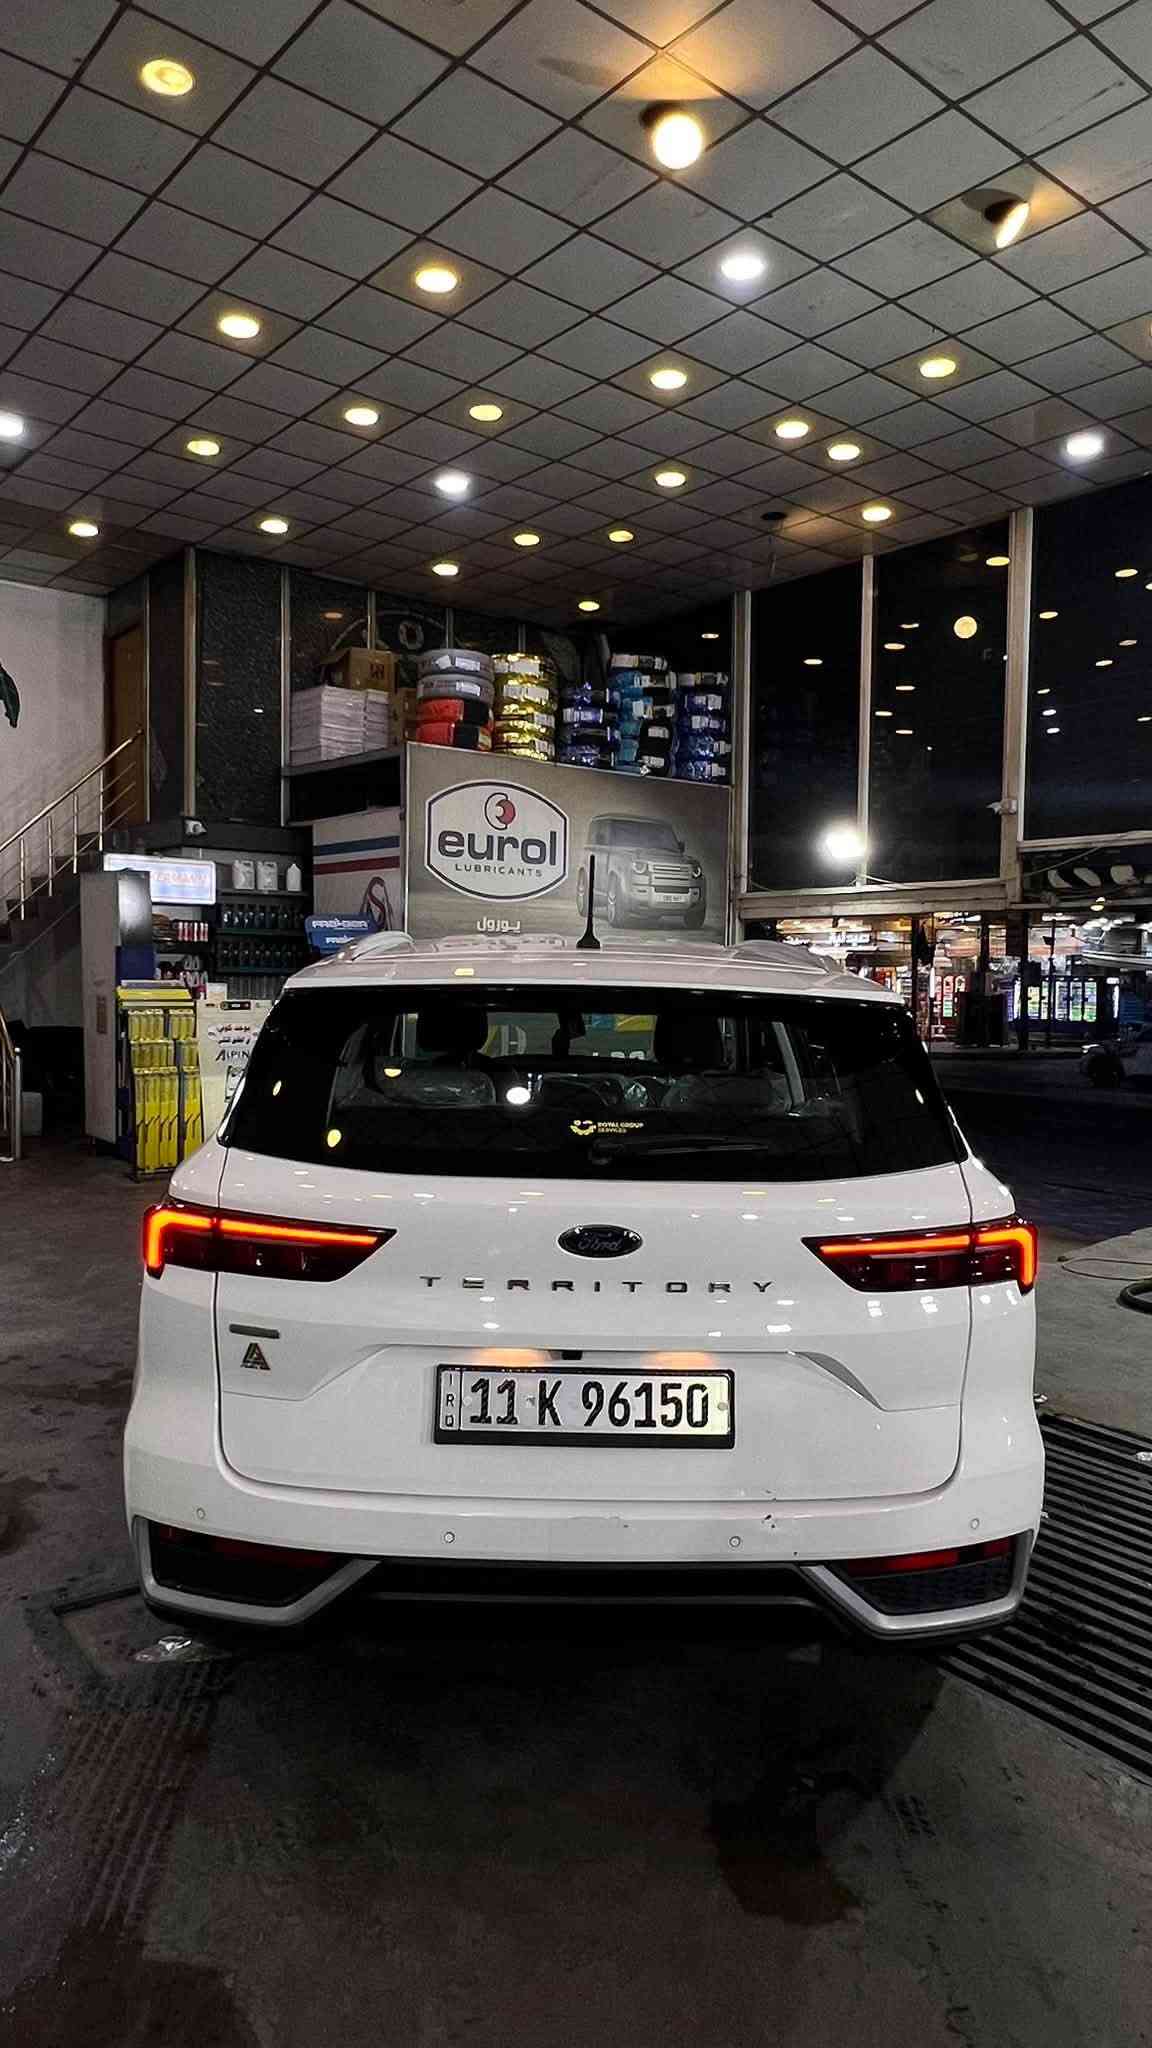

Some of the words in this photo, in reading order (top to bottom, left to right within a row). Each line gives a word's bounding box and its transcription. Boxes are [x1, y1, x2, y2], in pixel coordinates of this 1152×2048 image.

[438, 830, 557, 866] eurol
[455, 863, 542, 877] LUBRICANTS
[476, 916, 521, 933] يورول
[576, 1232, 625, 1251] Ford
[420, 1275, 773, 1293] TERRITORY
[470, 1378, 518, 1425] 11
[538, 1380, 562, 1426] K
[581, 1381, 709, 1428] 96150
